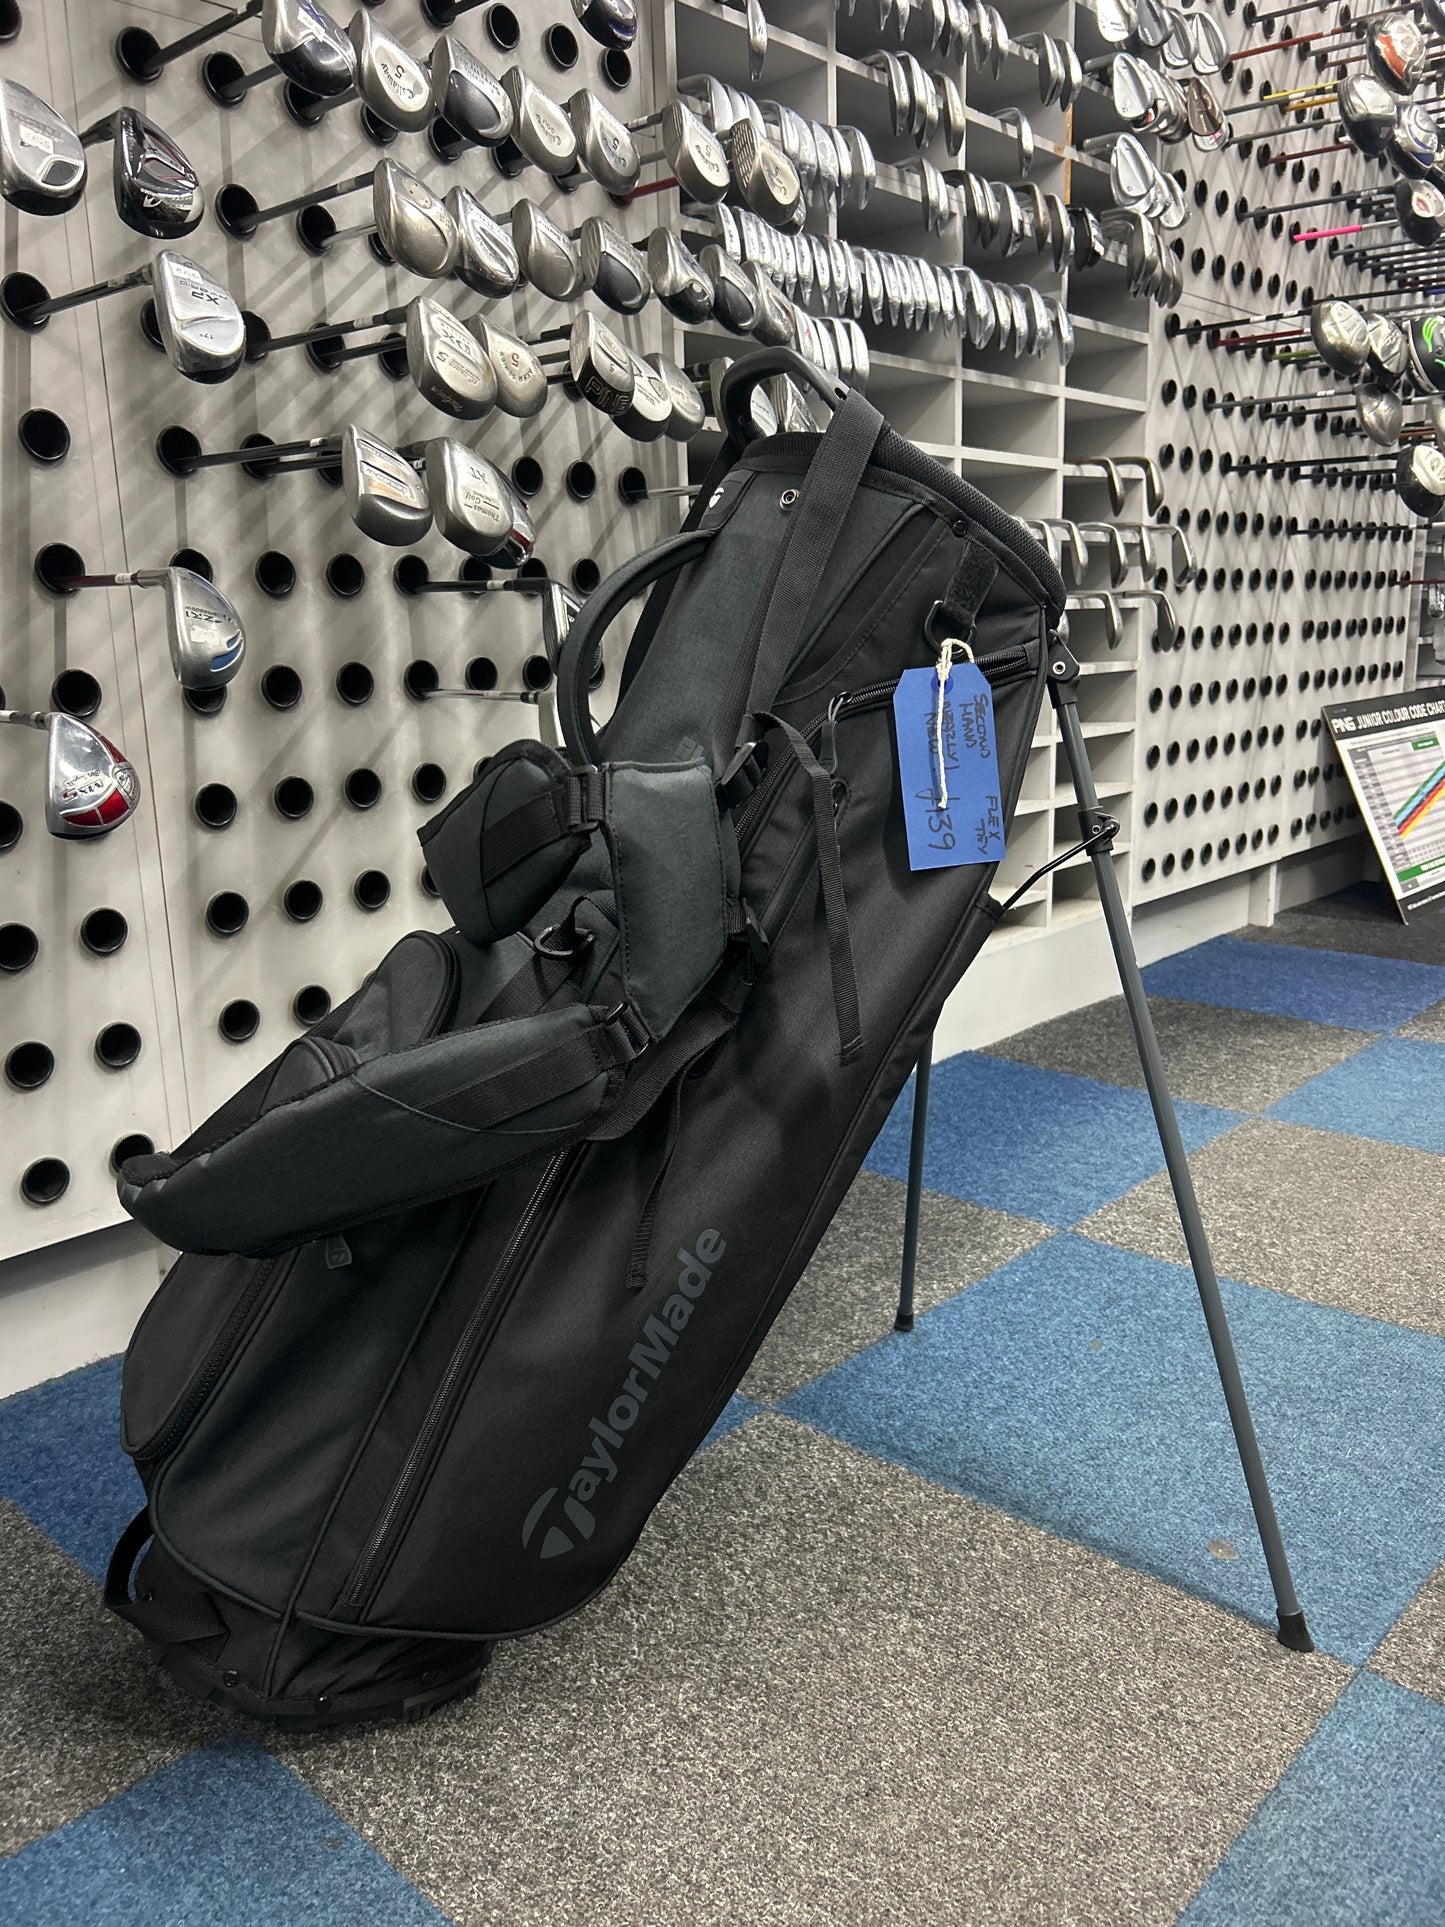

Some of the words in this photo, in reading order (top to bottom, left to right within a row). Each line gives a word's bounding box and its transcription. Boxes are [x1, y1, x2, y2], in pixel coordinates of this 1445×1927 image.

[394, 64, 405, 80] 5
[380, 62, 415, 100] Callaway
[611, 137, 620, 151] 5
[705, 144, 712, 157] 5
[191, 291, 219, 306] XP
[437, 350, 449, 364] 5
[510, 352, 520, 368] 5
[517, 367, 534, 383] ACER
[585, 375, 630, 414] PING
[463, 491, 482, 505] Golf
[472, 504, 501, 523] Thomas
[1356, 711, 1383, 729] JUNIOR
[1381, 706, 1411, 725] COLOUR
[1409, 703, 1429, 720] CODE
[959, 702, 977, 748] HAND
[974, 693, 991, 758] SECOND
[986, 795, 1001, 840] FLEX
[522, 1228, 727, 1559] TaylorMade
